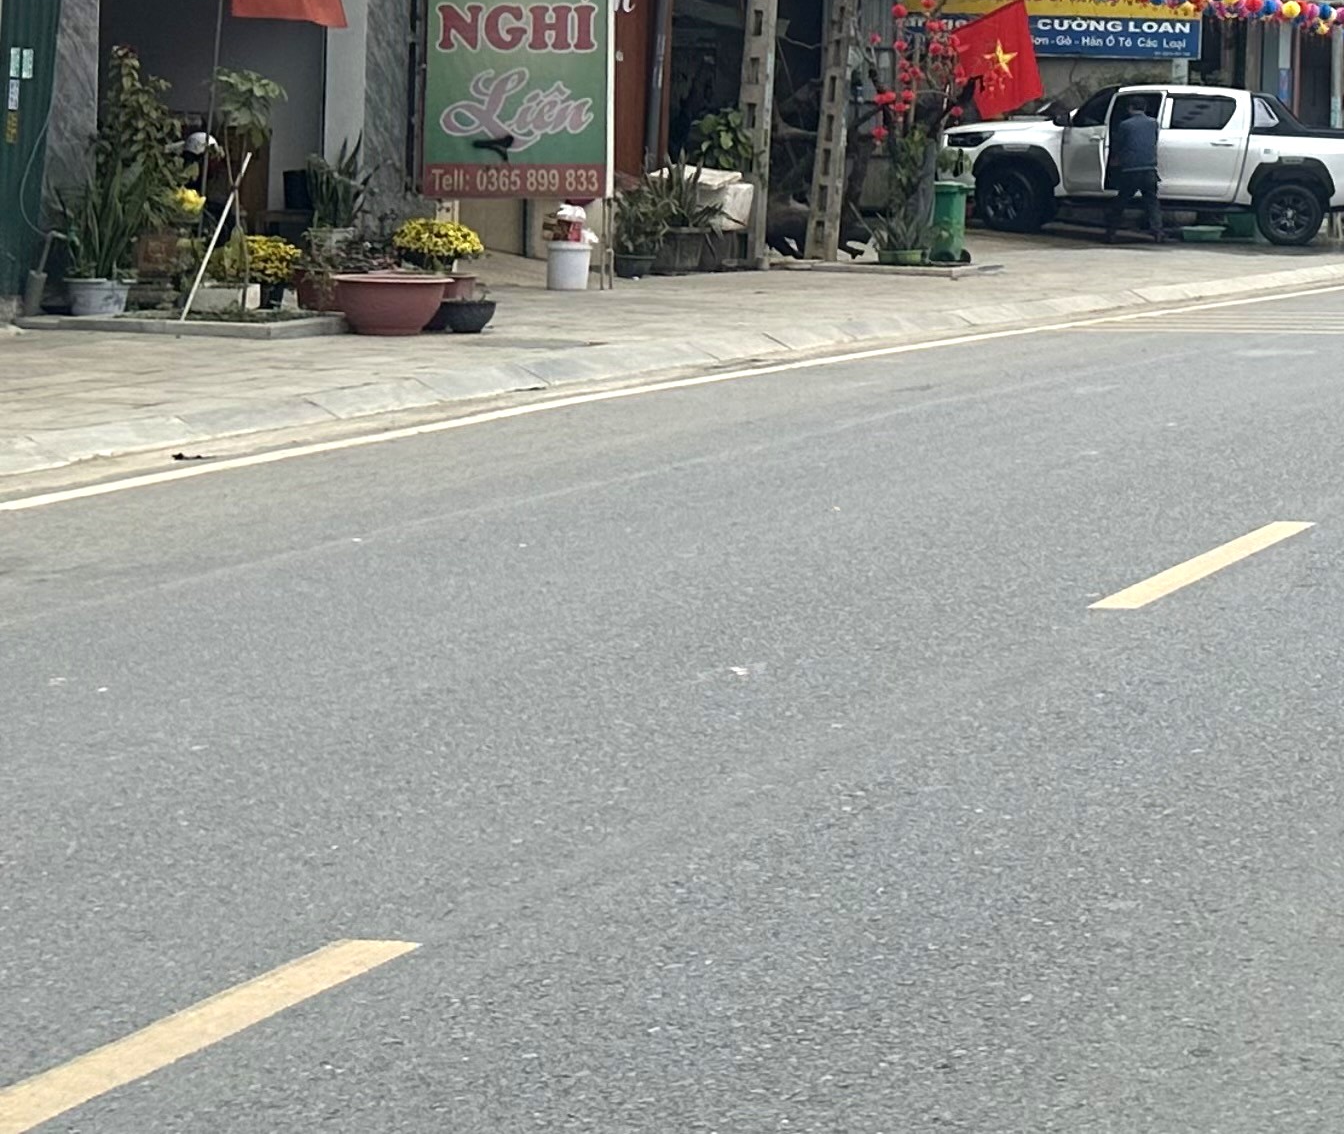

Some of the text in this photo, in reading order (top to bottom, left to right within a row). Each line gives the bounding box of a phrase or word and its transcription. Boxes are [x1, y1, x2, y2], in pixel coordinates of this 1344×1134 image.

[1128, 21, 1191, 34] LOAN
[440, 67, 594, 153] Liên
[431, 169, 599, 193] Tell: 0365 899 833
